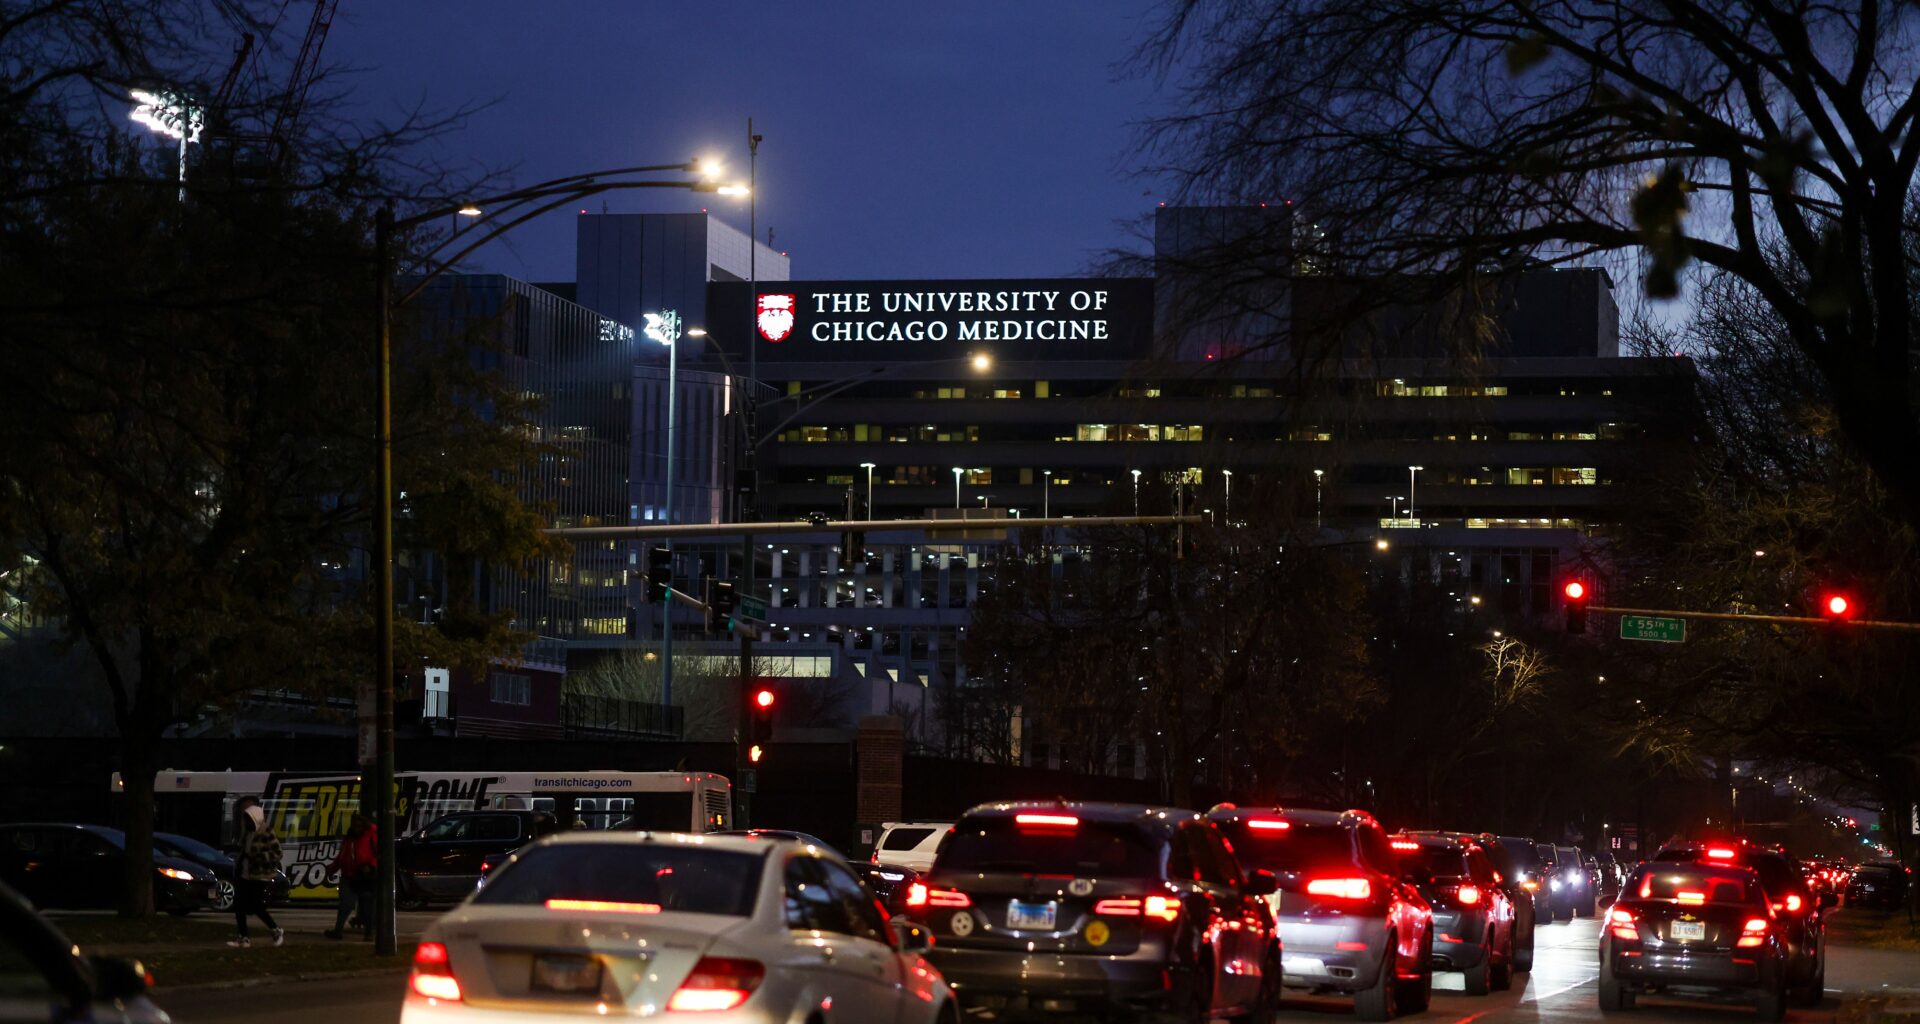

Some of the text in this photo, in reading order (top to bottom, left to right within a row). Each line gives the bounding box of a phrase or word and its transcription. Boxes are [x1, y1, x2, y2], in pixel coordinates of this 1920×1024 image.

[811, 290, 1109, 313] THE UNIVERSITY OF
[811, 320, 1109, 342] CHICAGO MEDICINE
[534, 777, 632, 790] transitchicago.com
[296, 842, 341, 862] INJU
